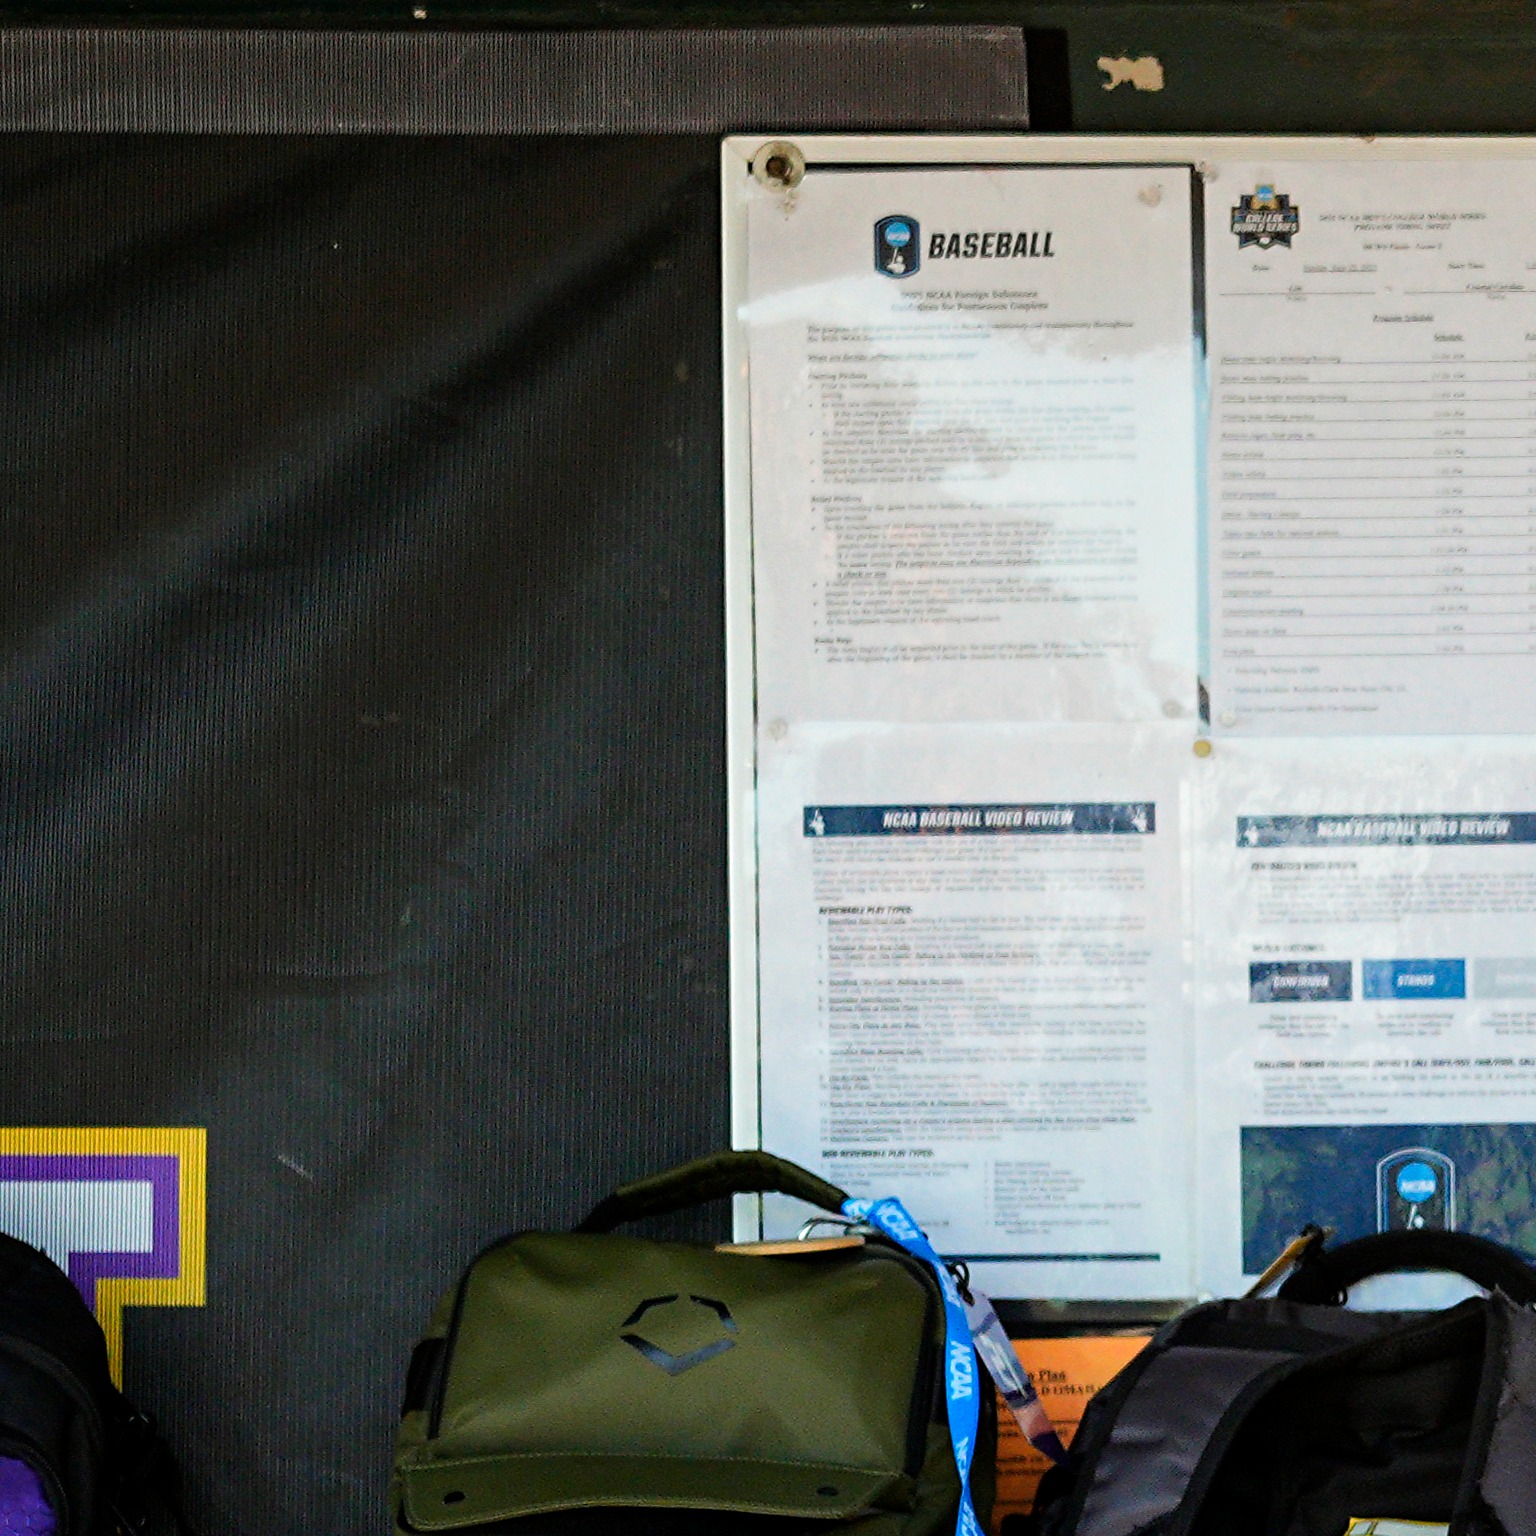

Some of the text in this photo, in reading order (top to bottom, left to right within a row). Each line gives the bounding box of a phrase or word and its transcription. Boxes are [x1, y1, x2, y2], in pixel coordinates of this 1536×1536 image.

[928, 231, 1055, 259] BASEBALL
[883, 808, 1076, 828] NCAA BASEBALL VIDEO REVIEW
[1418, 819, 1459, 836] VIDEO
[1459, 818, 1511, 836] REVIEW
[950, 1339, 973, 1401] NCAA
